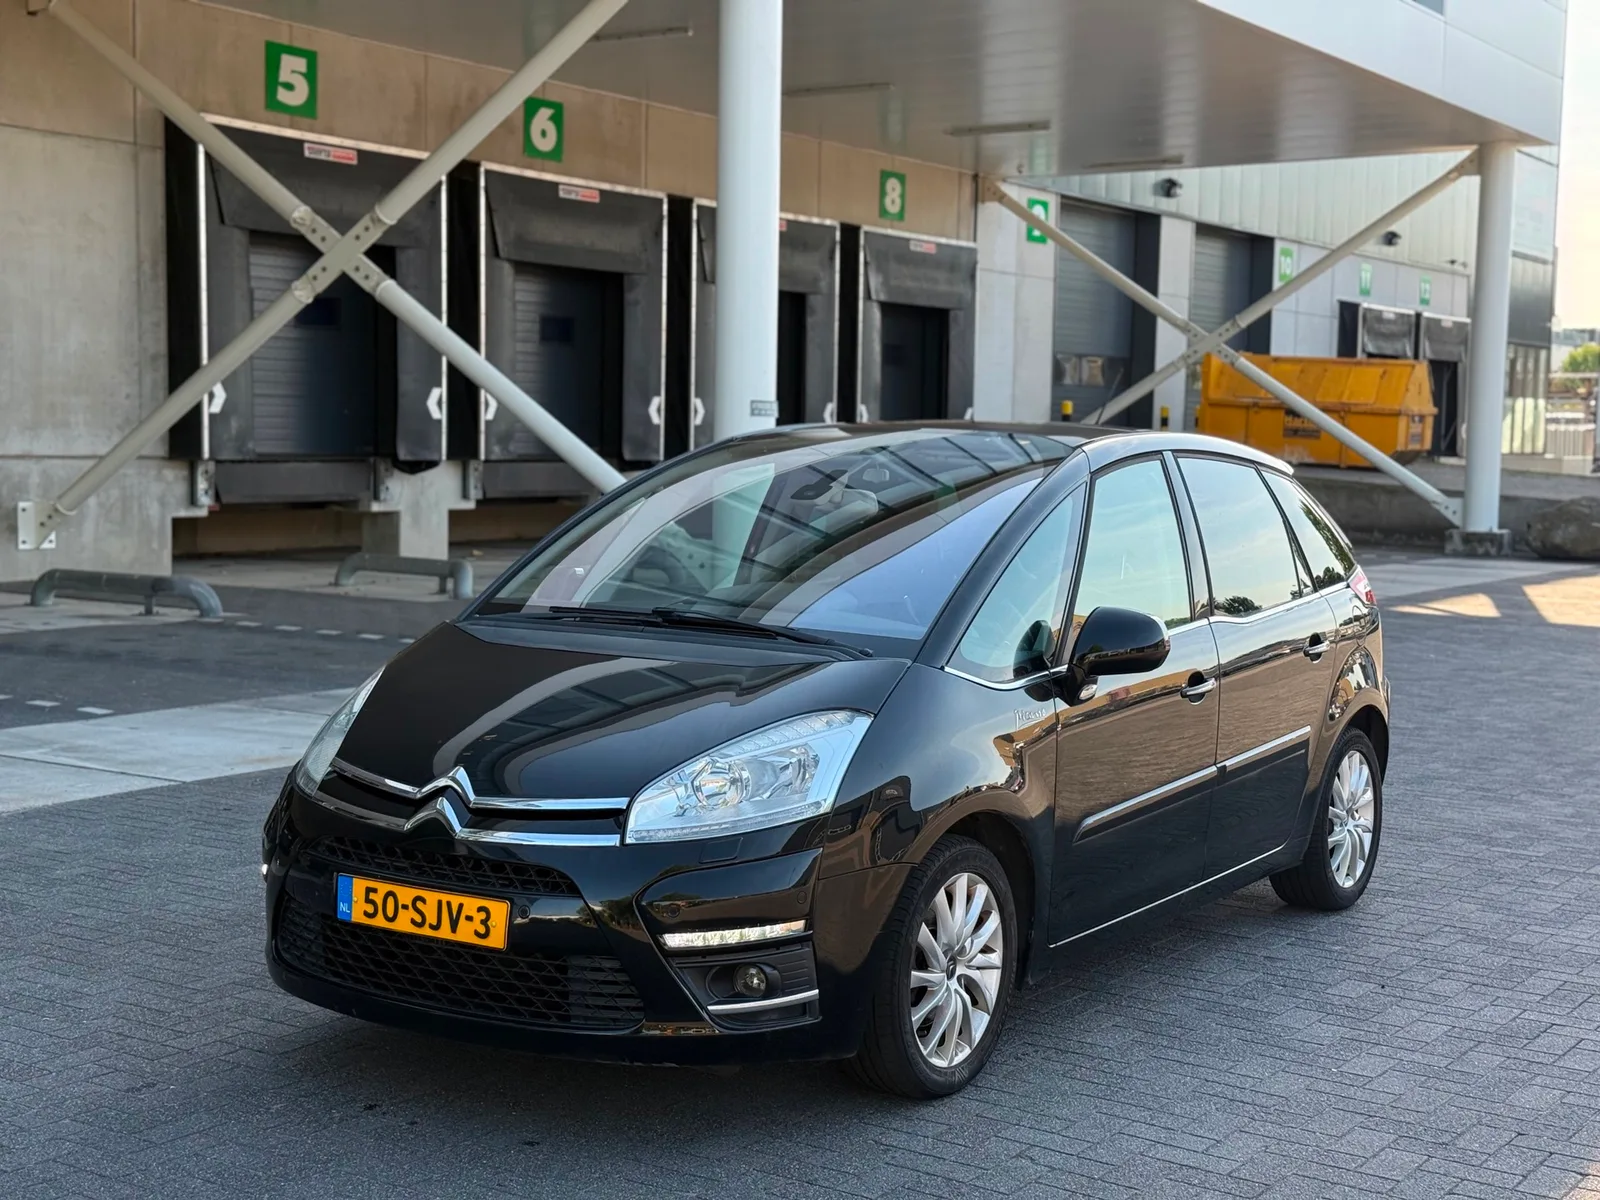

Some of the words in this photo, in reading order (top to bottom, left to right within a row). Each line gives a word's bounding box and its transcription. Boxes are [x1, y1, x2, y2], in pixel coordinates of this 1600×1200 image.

[276, 52, 310, 107] 5
[529, 106, 558, 153] 6
[884, 176, 902, 214] 8
[1280, 255, 1292, 275] 10
[339, 901, 351, 913] NL
[363, 886, 491, 940] 50-SJV-3
